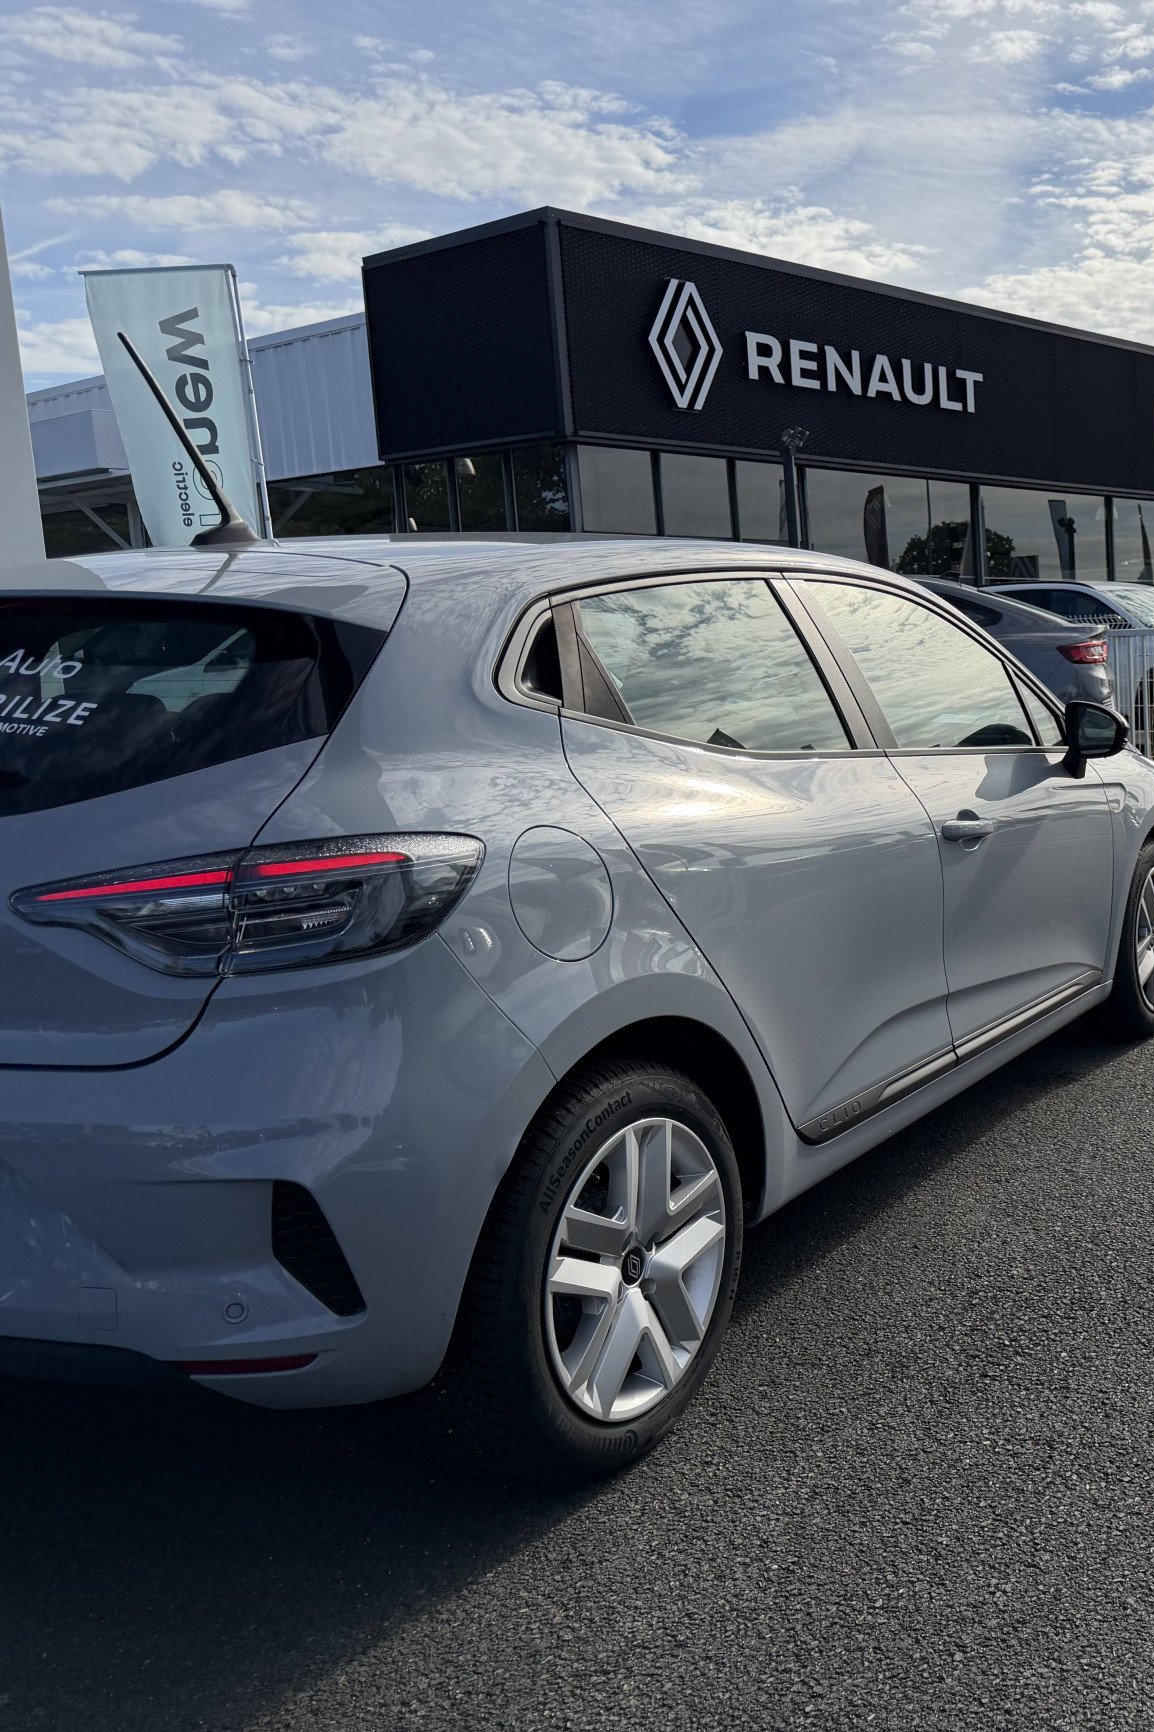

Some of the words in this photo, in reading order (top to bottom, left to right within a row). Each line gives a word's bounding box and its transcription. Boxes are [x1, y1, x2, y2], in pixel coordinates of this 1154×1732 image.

[744, 330, 984, 413] RENAULT
[0, 648, 83, 679] Auto
[819, 1101, 862, 1132] CLIO
[538, 1090, 633, 1215] AllSeasonContact
